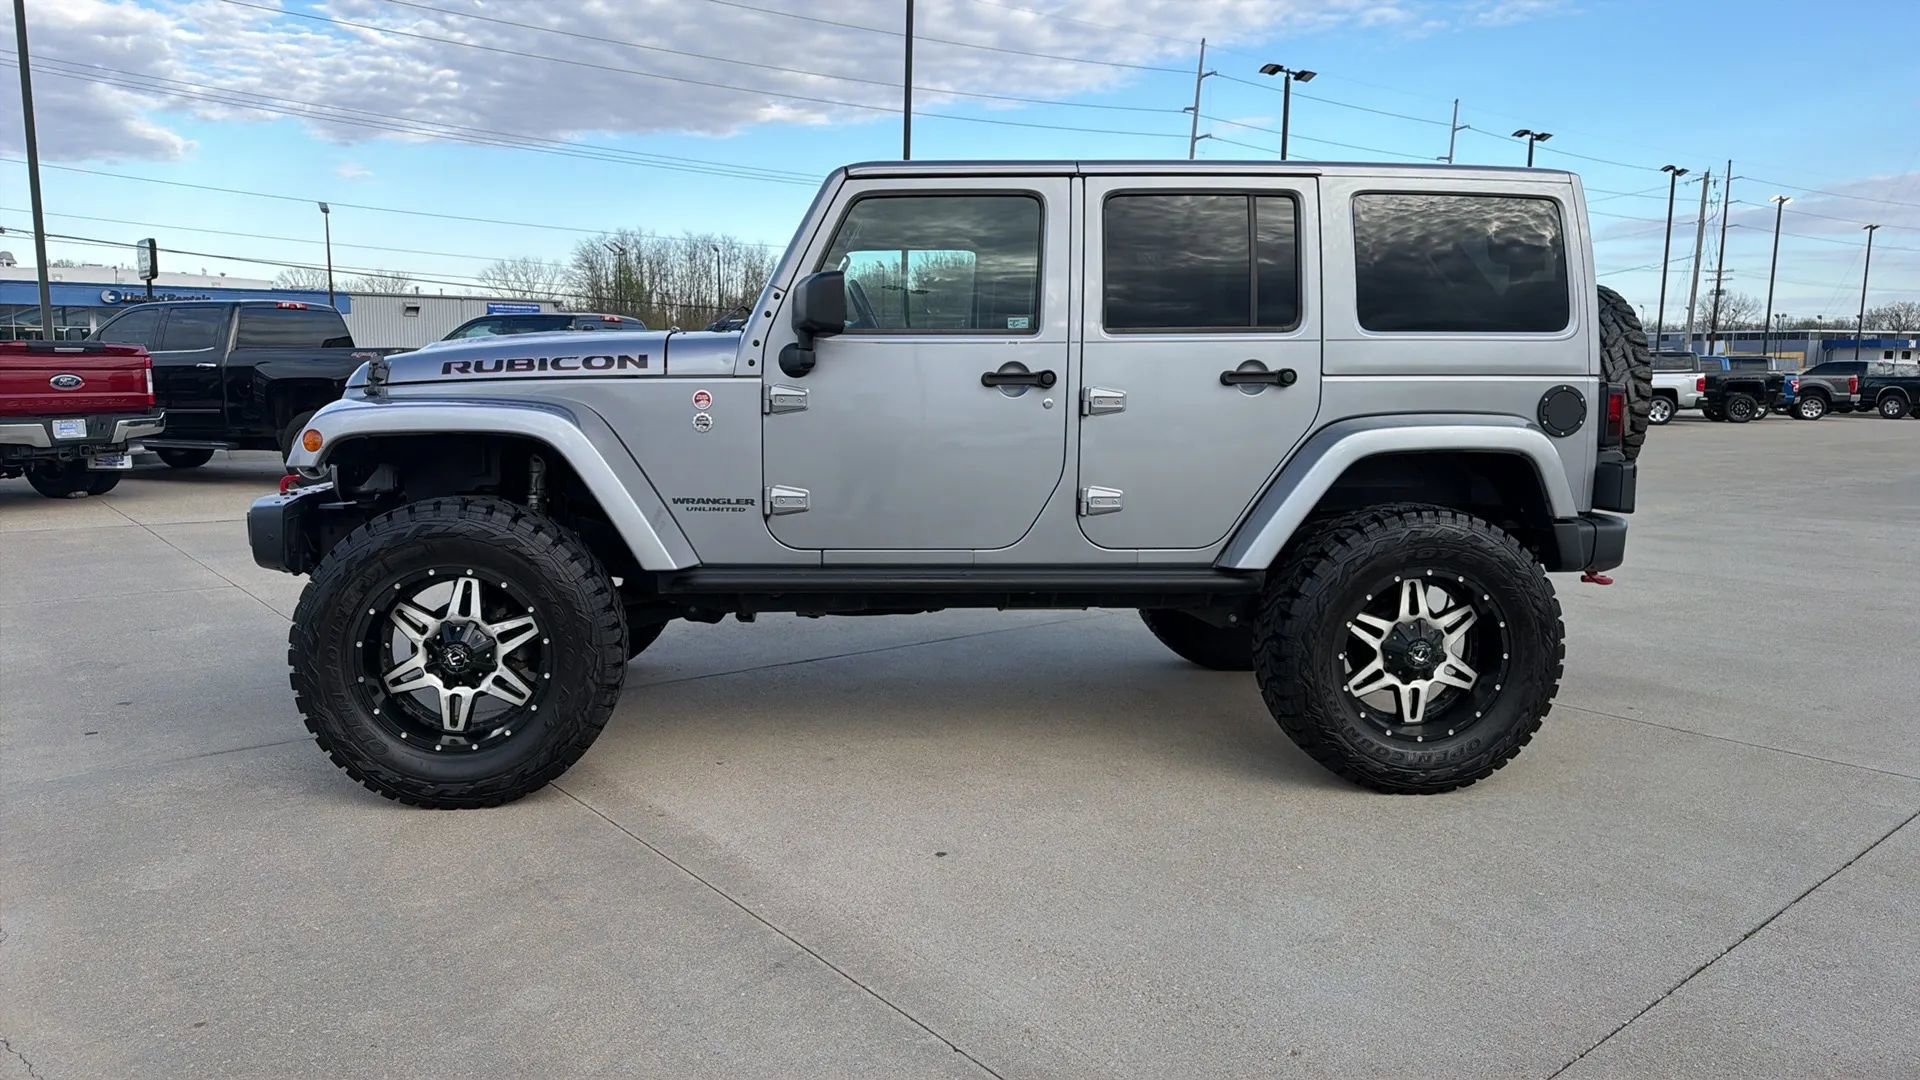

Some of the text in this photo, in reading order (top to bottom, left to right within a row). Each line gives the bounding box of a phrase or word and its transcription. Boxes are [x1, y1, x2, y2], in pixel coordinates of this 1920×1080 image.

[441, 354, 649, 375] RUBICON
[59, 377, 76, 386] Ford
[672, 497, 755, 506] WRANGLER
